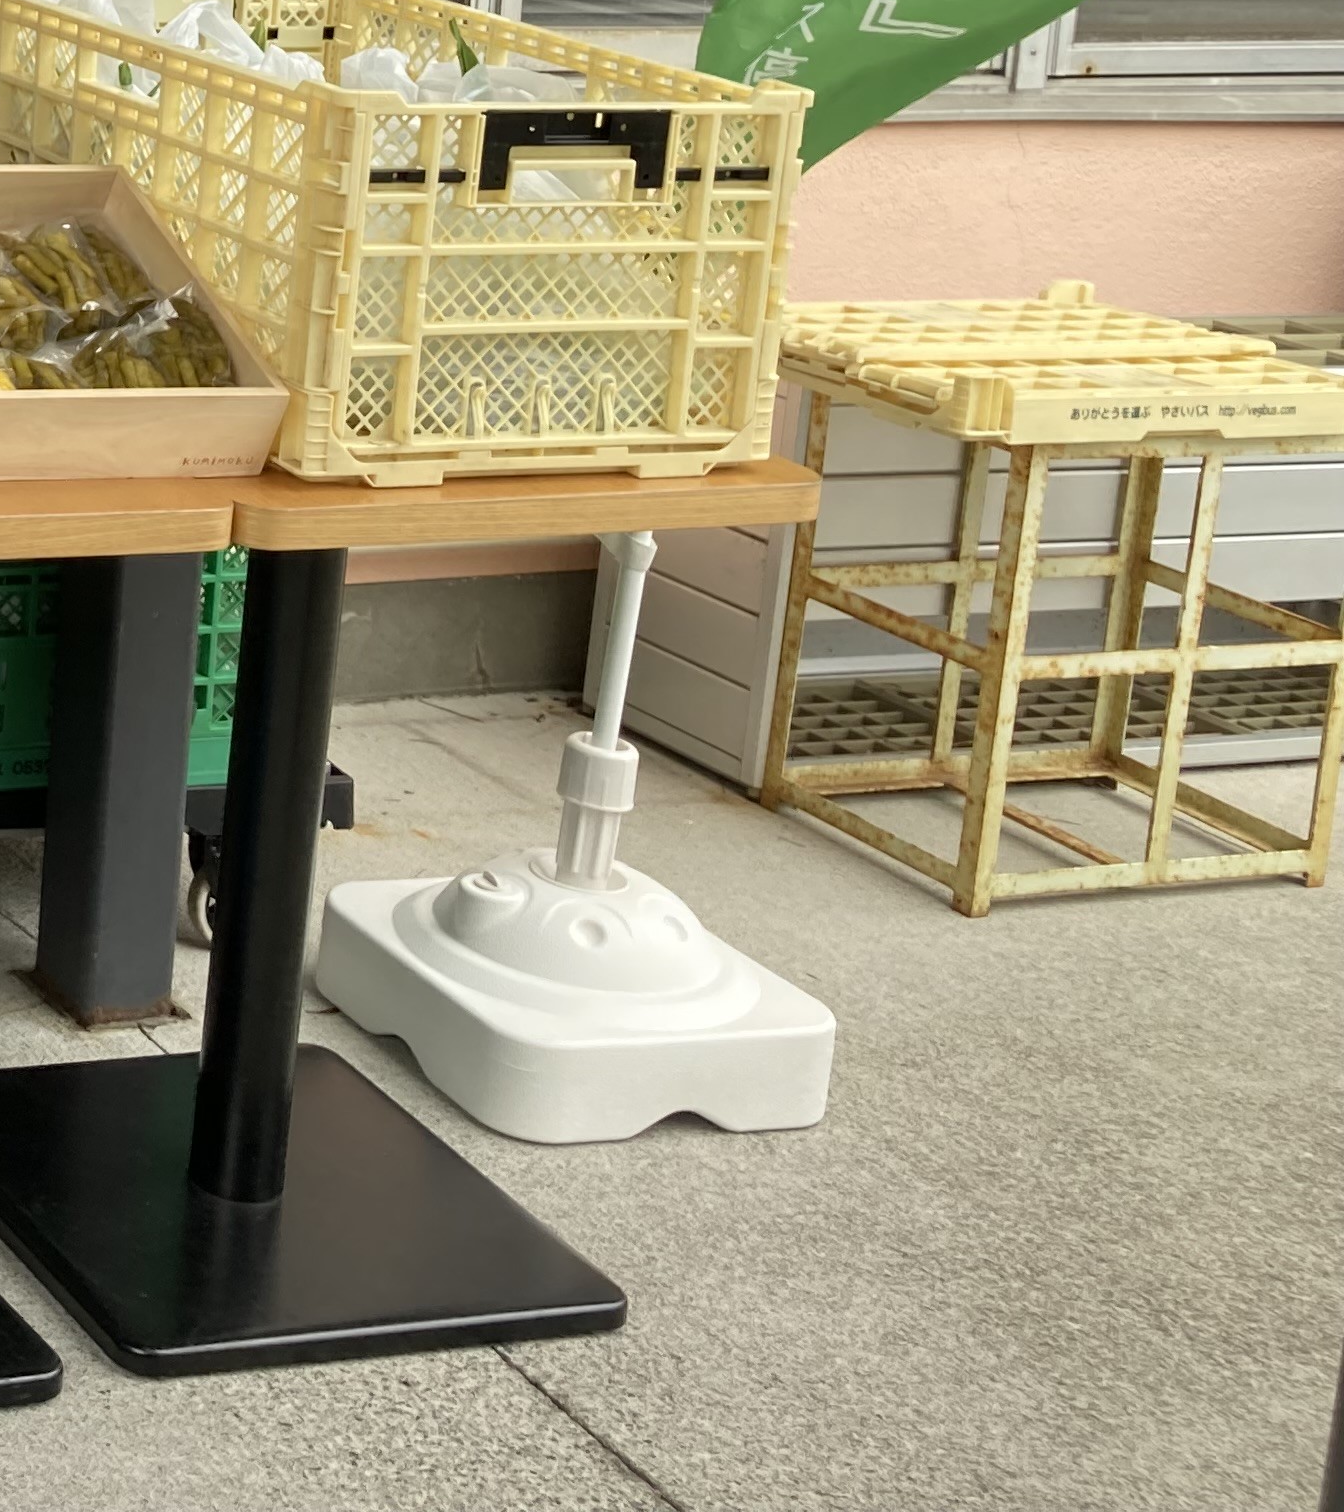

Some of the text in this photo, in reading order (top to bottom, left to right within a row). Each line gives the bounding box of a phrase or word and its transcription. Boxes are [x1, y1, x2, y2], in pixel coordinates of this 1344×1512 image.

[1161, 404, 1209, 419] やさいバス
[182, 456, 254, 466] KUMIMOKU
